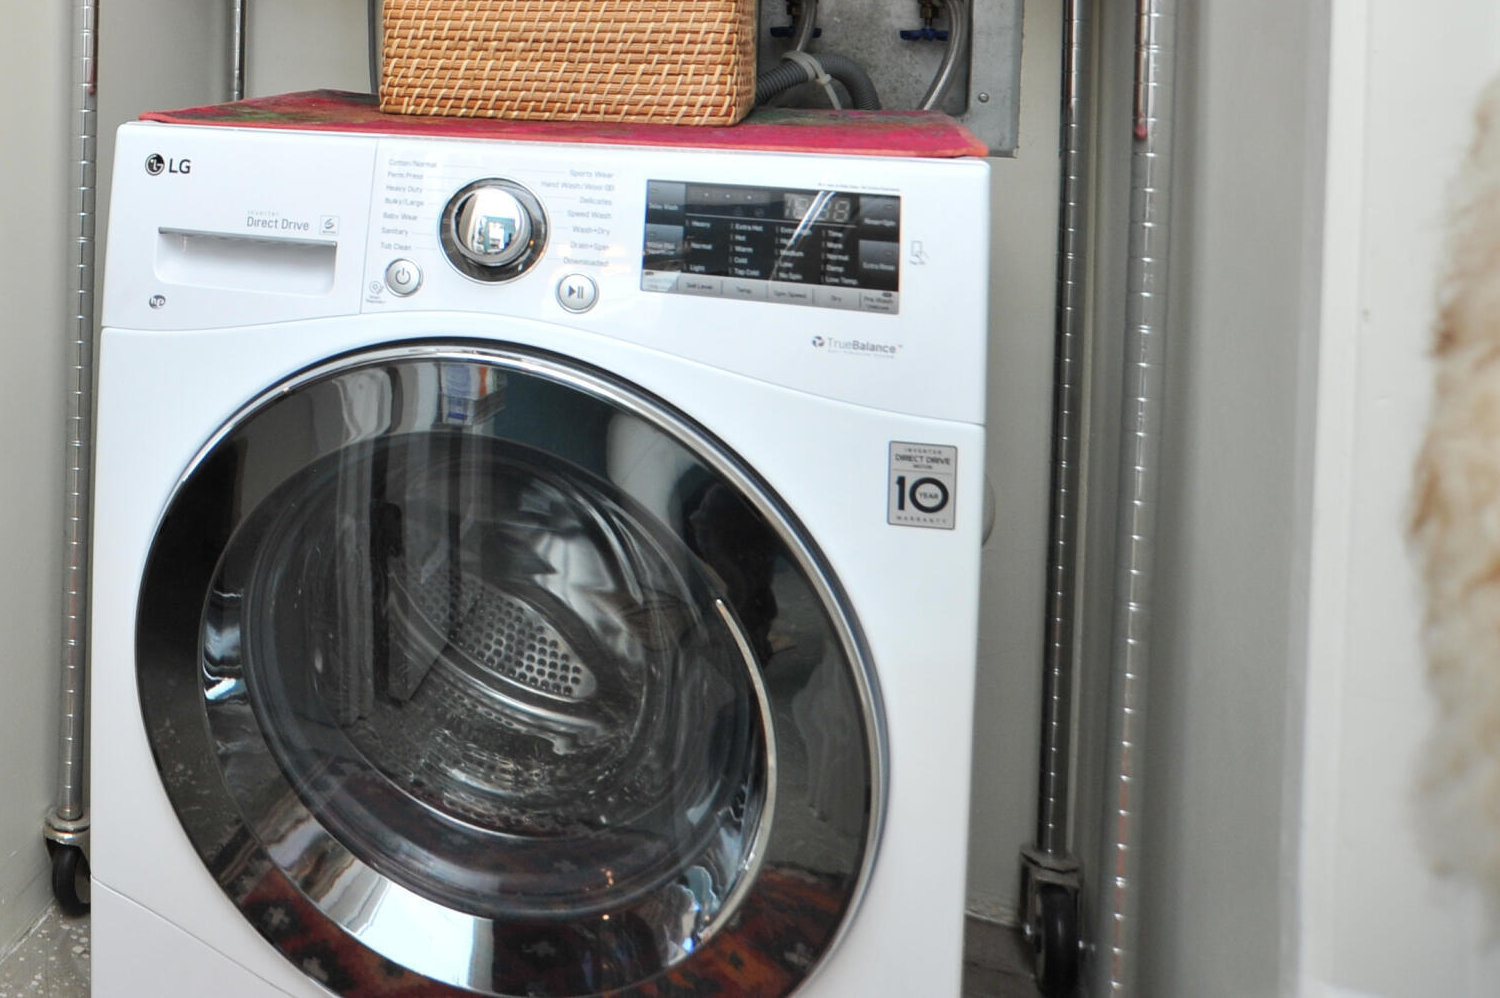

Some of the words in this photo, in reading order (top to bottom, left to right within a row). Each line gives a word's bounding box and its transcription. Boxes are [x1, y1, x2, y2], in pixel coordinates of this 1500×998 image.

[168, 158, 191, 175] LG
[386, 185, 406, 193] Heavy
[408, 185, 423, 193] Duty
[246, 216, 278, 229] Direct
[281, 218, 309, 232] Drive
[895, 453, 924, 463] DIRECT
[926, 455, 951, 466] DRIVE
[895, 475, 949, 514] 10
[918, 491, 939, 500] YEAR
[896, 515, 947, 525] WARRANTY
